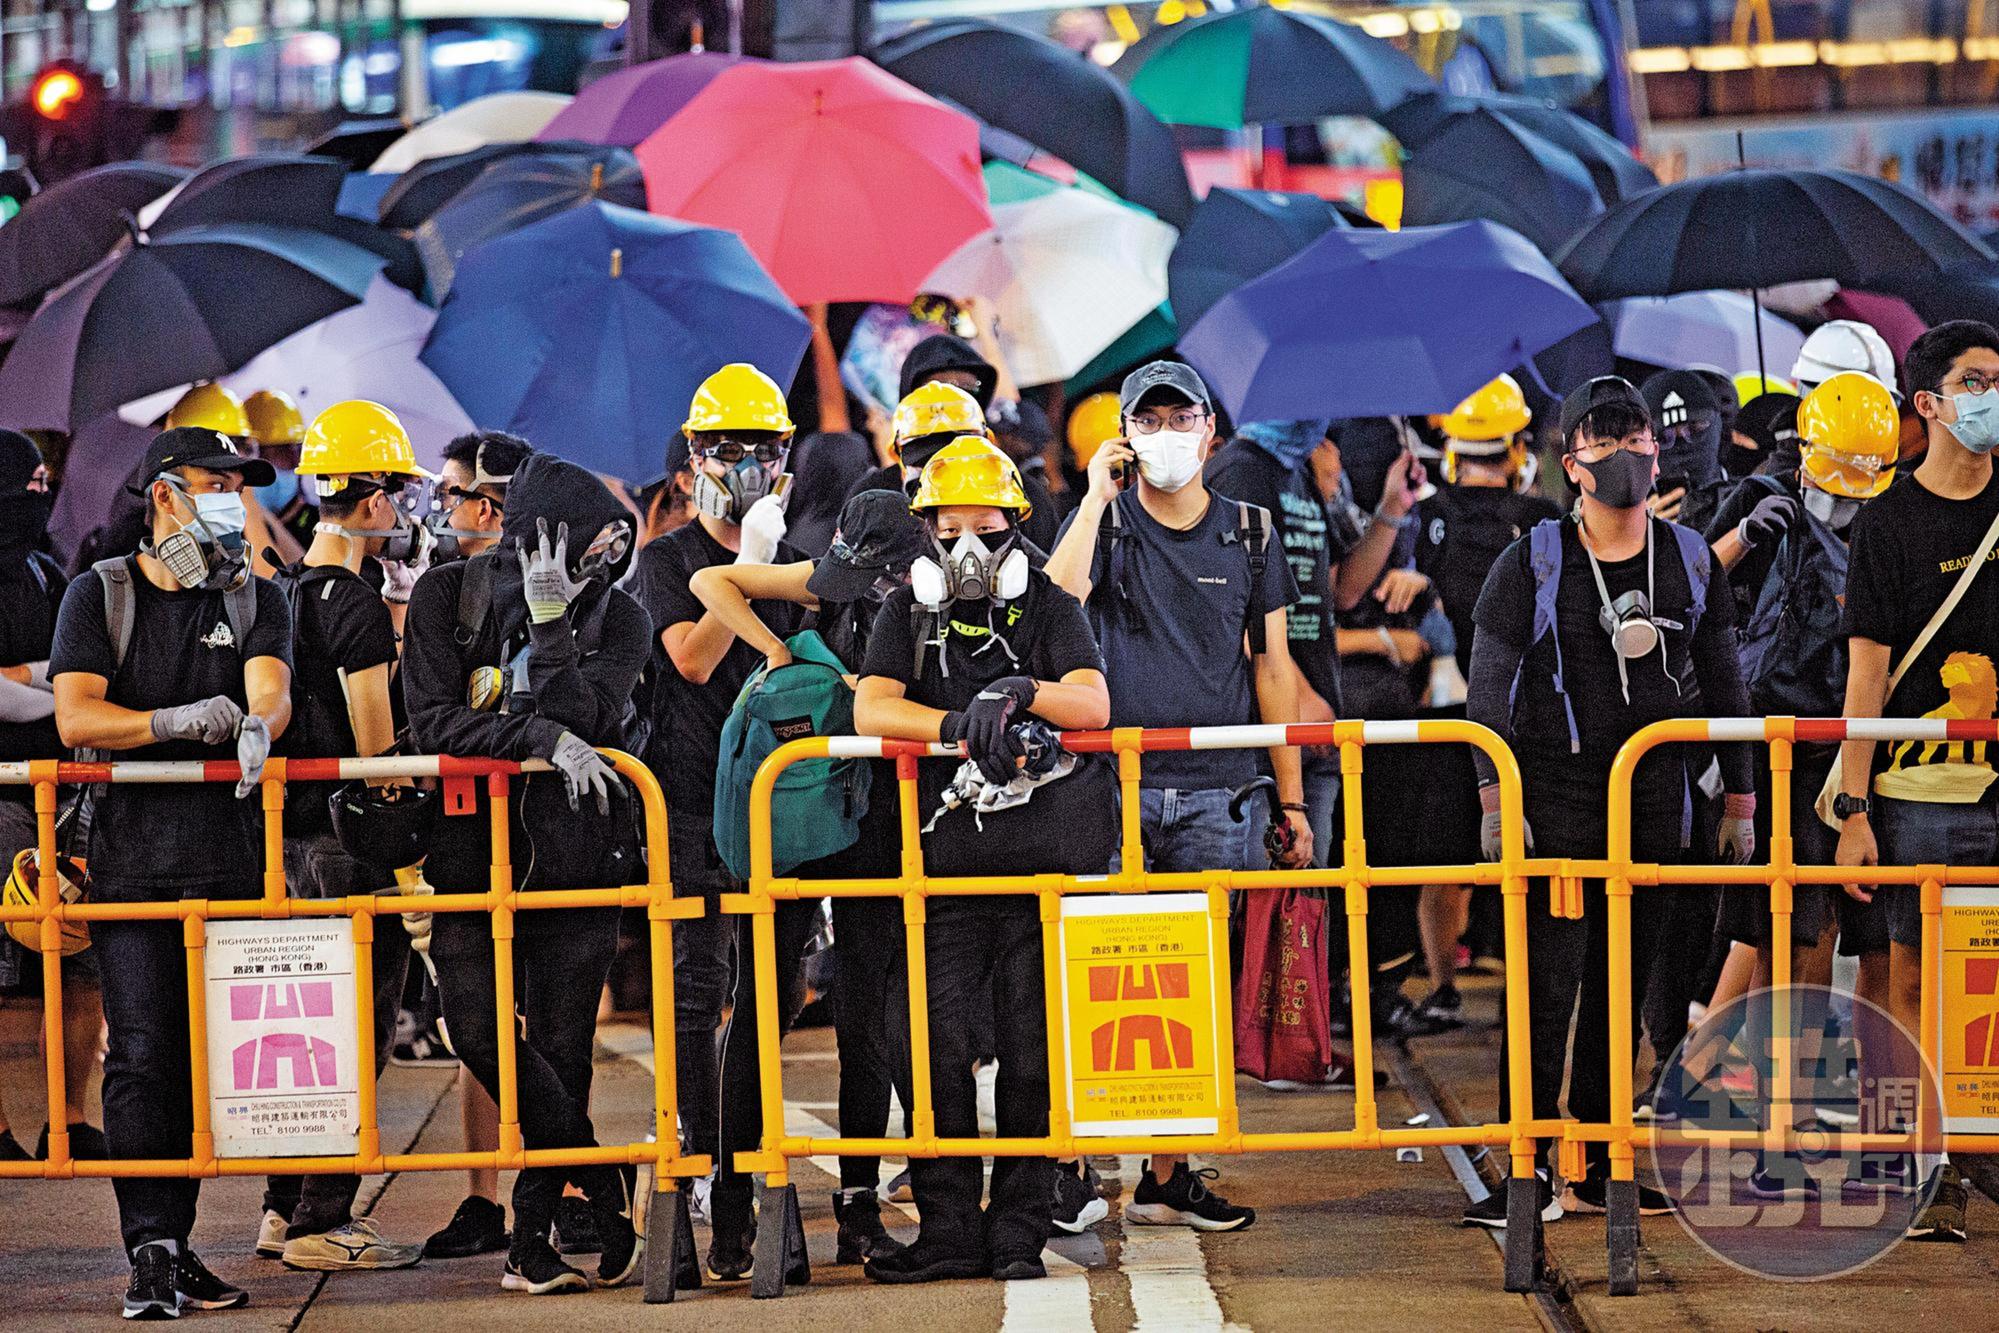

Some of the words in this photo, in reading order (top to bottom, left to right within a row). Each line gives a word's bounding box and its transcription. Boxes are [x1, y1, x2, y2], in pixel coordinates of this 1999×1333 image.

[1938, 554, 1975, 573] READ
[1075, 917, 1128, 926] HIGHWAYS
[1129, 914, 1195, 924] DEPARTMENT
[1101, 926, 1134, 934] URBAN
[1135, 925, 1172, 934] REGION
[217, 936, 270, 946] HIGHWAYS
[272, 934, 340, 944] DEPARTMENT
[243, 946, 276, 955] URBAN
[278, 944, 315, 953] REGION
[1091, 945, 1122, 955] 路政署
[248, 955, 279, 964] (HONG
[281, 953, 312, 962] KONG)
[232, 964, 265, 975] 路政署
[270, 963, 292, 973] 市區
[1135, 1108, 1158, 1117] 8100
[1160, 1107, 1183, 1116] 9988
[277, 1125, 300, 1135] 8100
[302, 1124, 326, 1133] 9988
